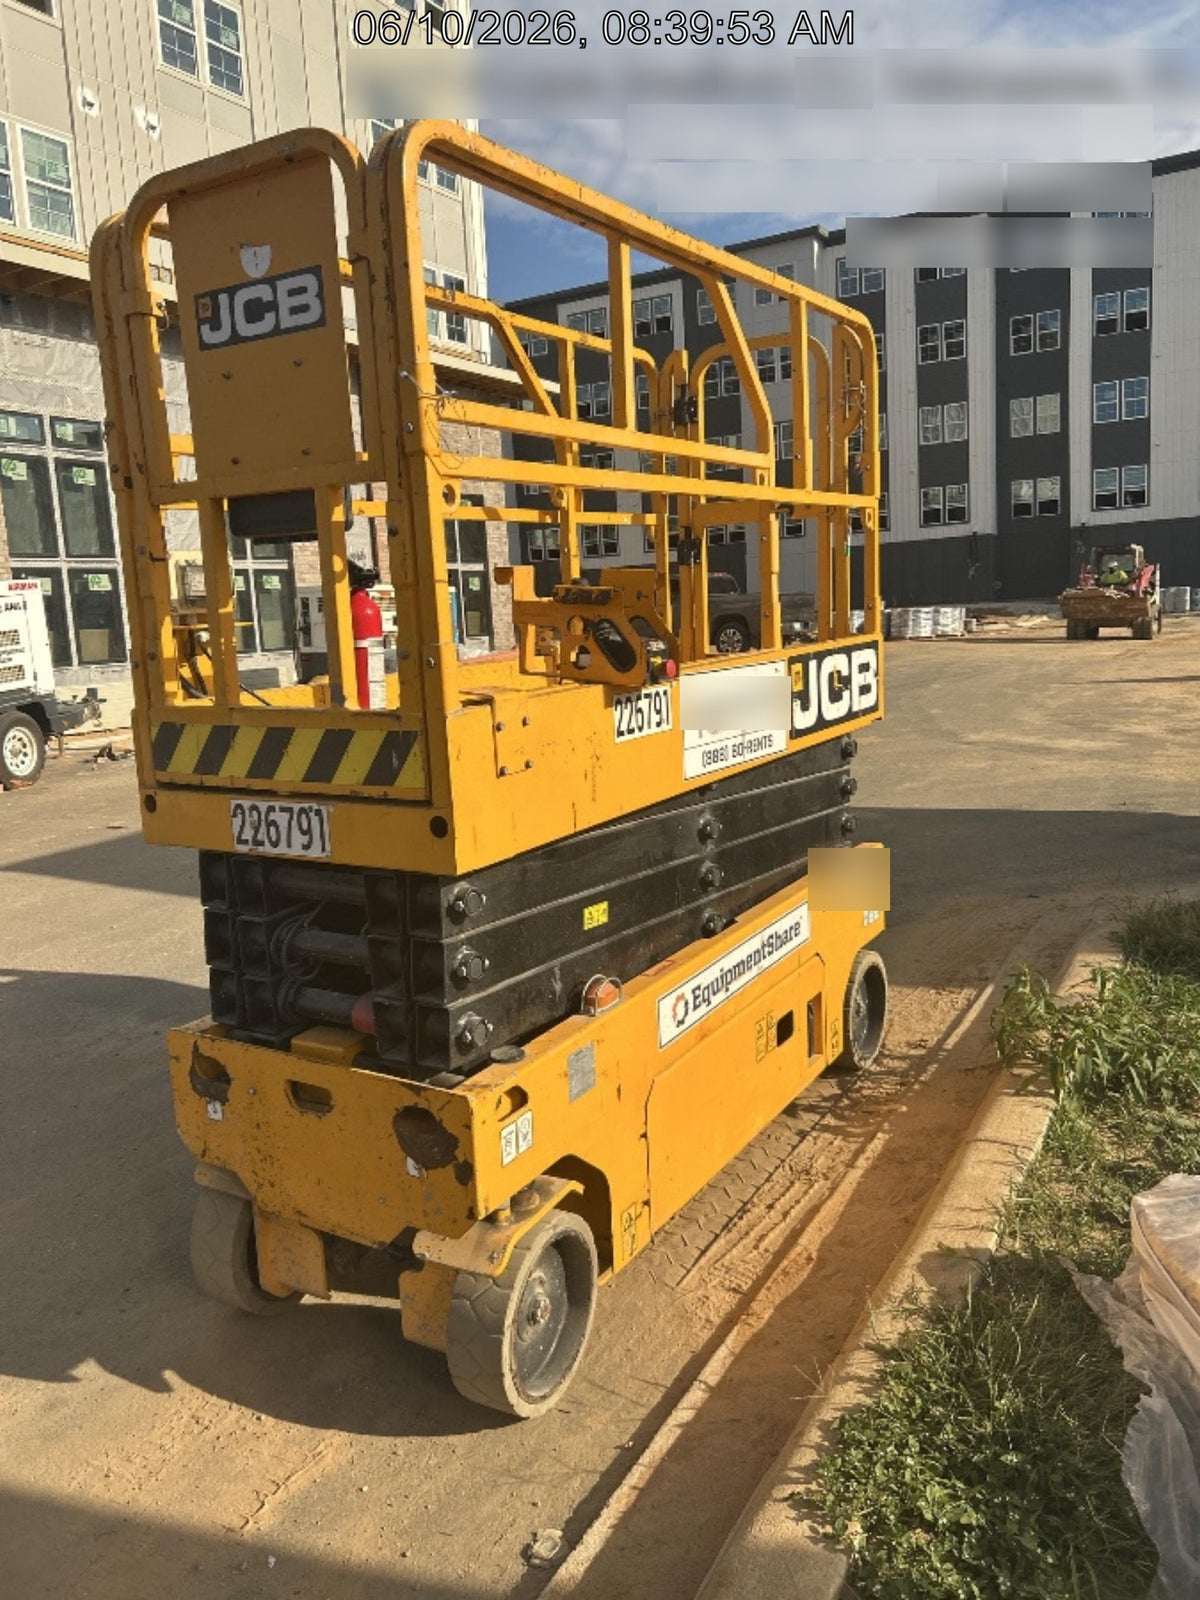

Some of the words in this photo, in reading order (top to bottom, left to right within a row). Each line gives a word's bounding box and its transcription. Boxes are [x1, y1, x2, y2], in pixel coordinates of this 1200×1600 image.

[200, 273, 322, 344] JCB
[614, 688, 671, 738] 226791
[792, 648, 878, 730] JCB
[231, 803, 326, 853] 226791
[691, 920, 802, 1012] EquipmentShare
